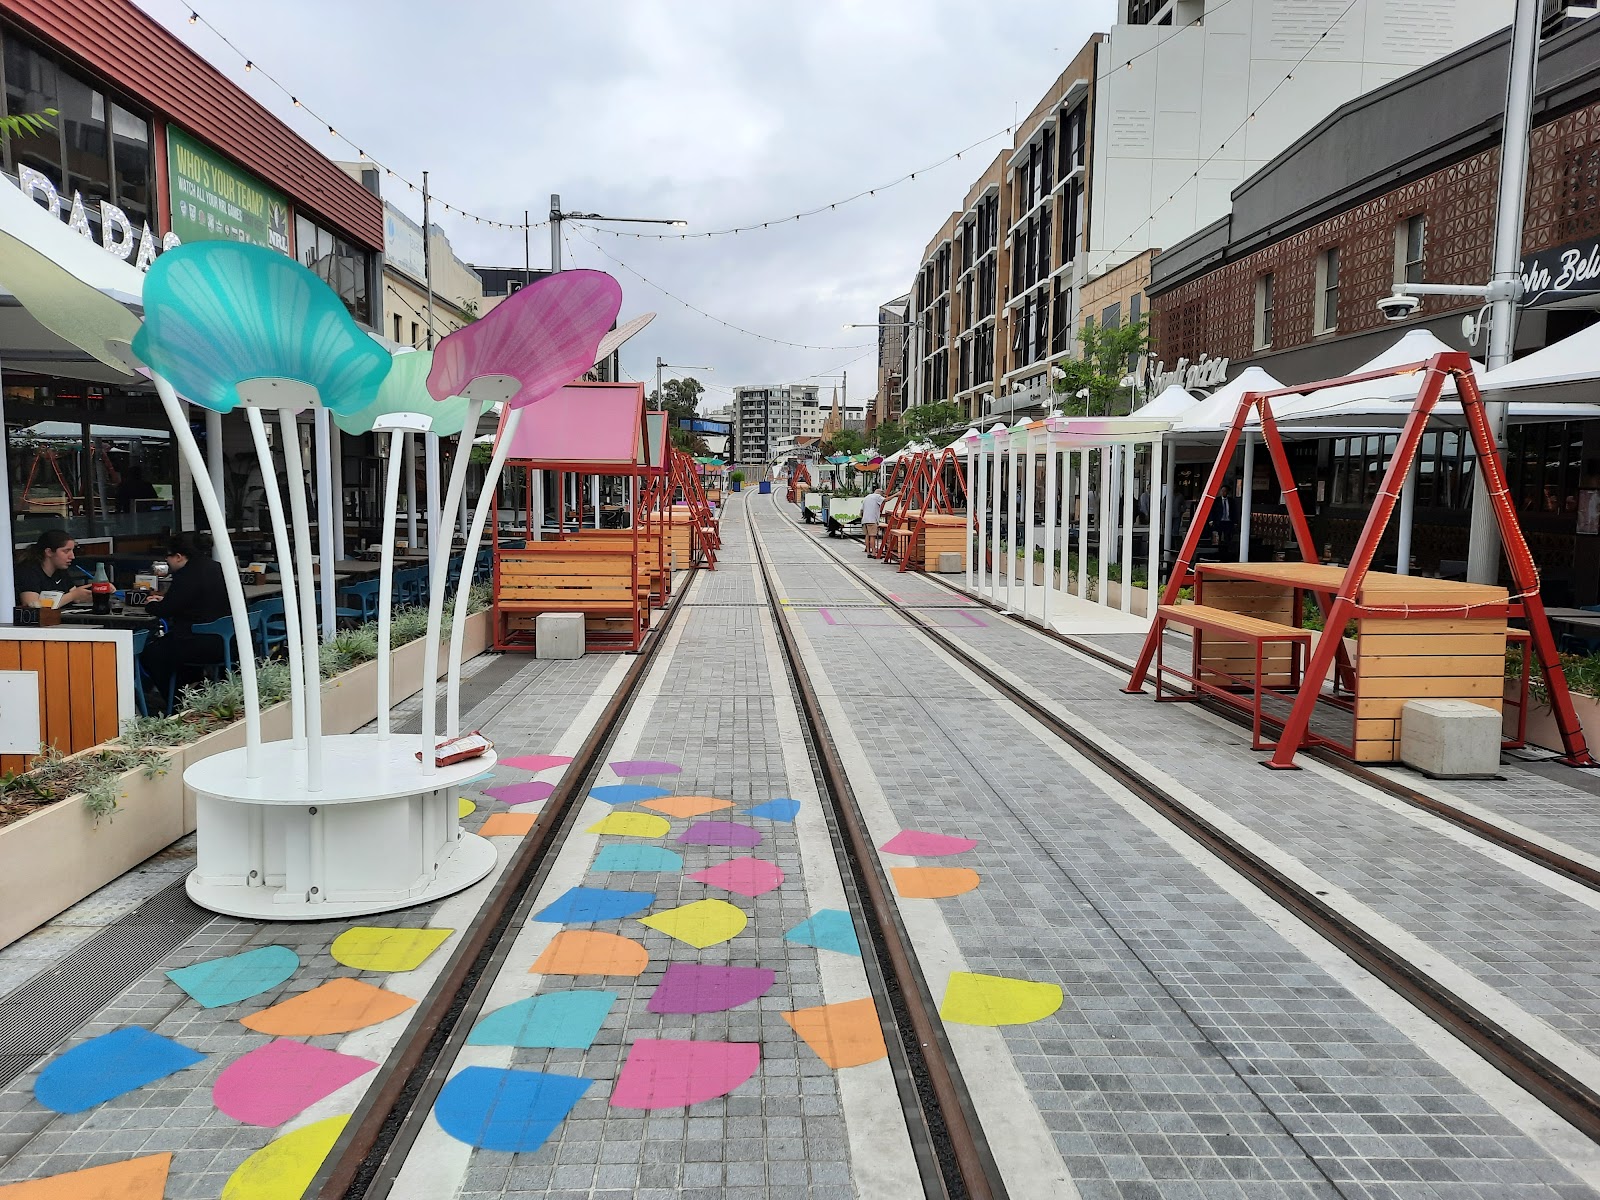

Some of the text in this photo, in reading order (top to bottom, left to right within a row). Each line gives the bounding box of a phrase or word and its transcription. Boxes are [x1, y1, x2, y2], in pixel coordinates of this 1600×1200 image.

[176, 143, 264, 219] WHO'S YOUR TEAM?
[178, 175, 197, 198] WATCH
[196, 186, 206, 204] ALL
[205, 190, 219, 210] YOUR
[269, 228, 288, 252] NRL
[1519, 259, 1552, 294] ohn
[126, 591, 147, 606] 702
[15, 608, 39, 624] 701
